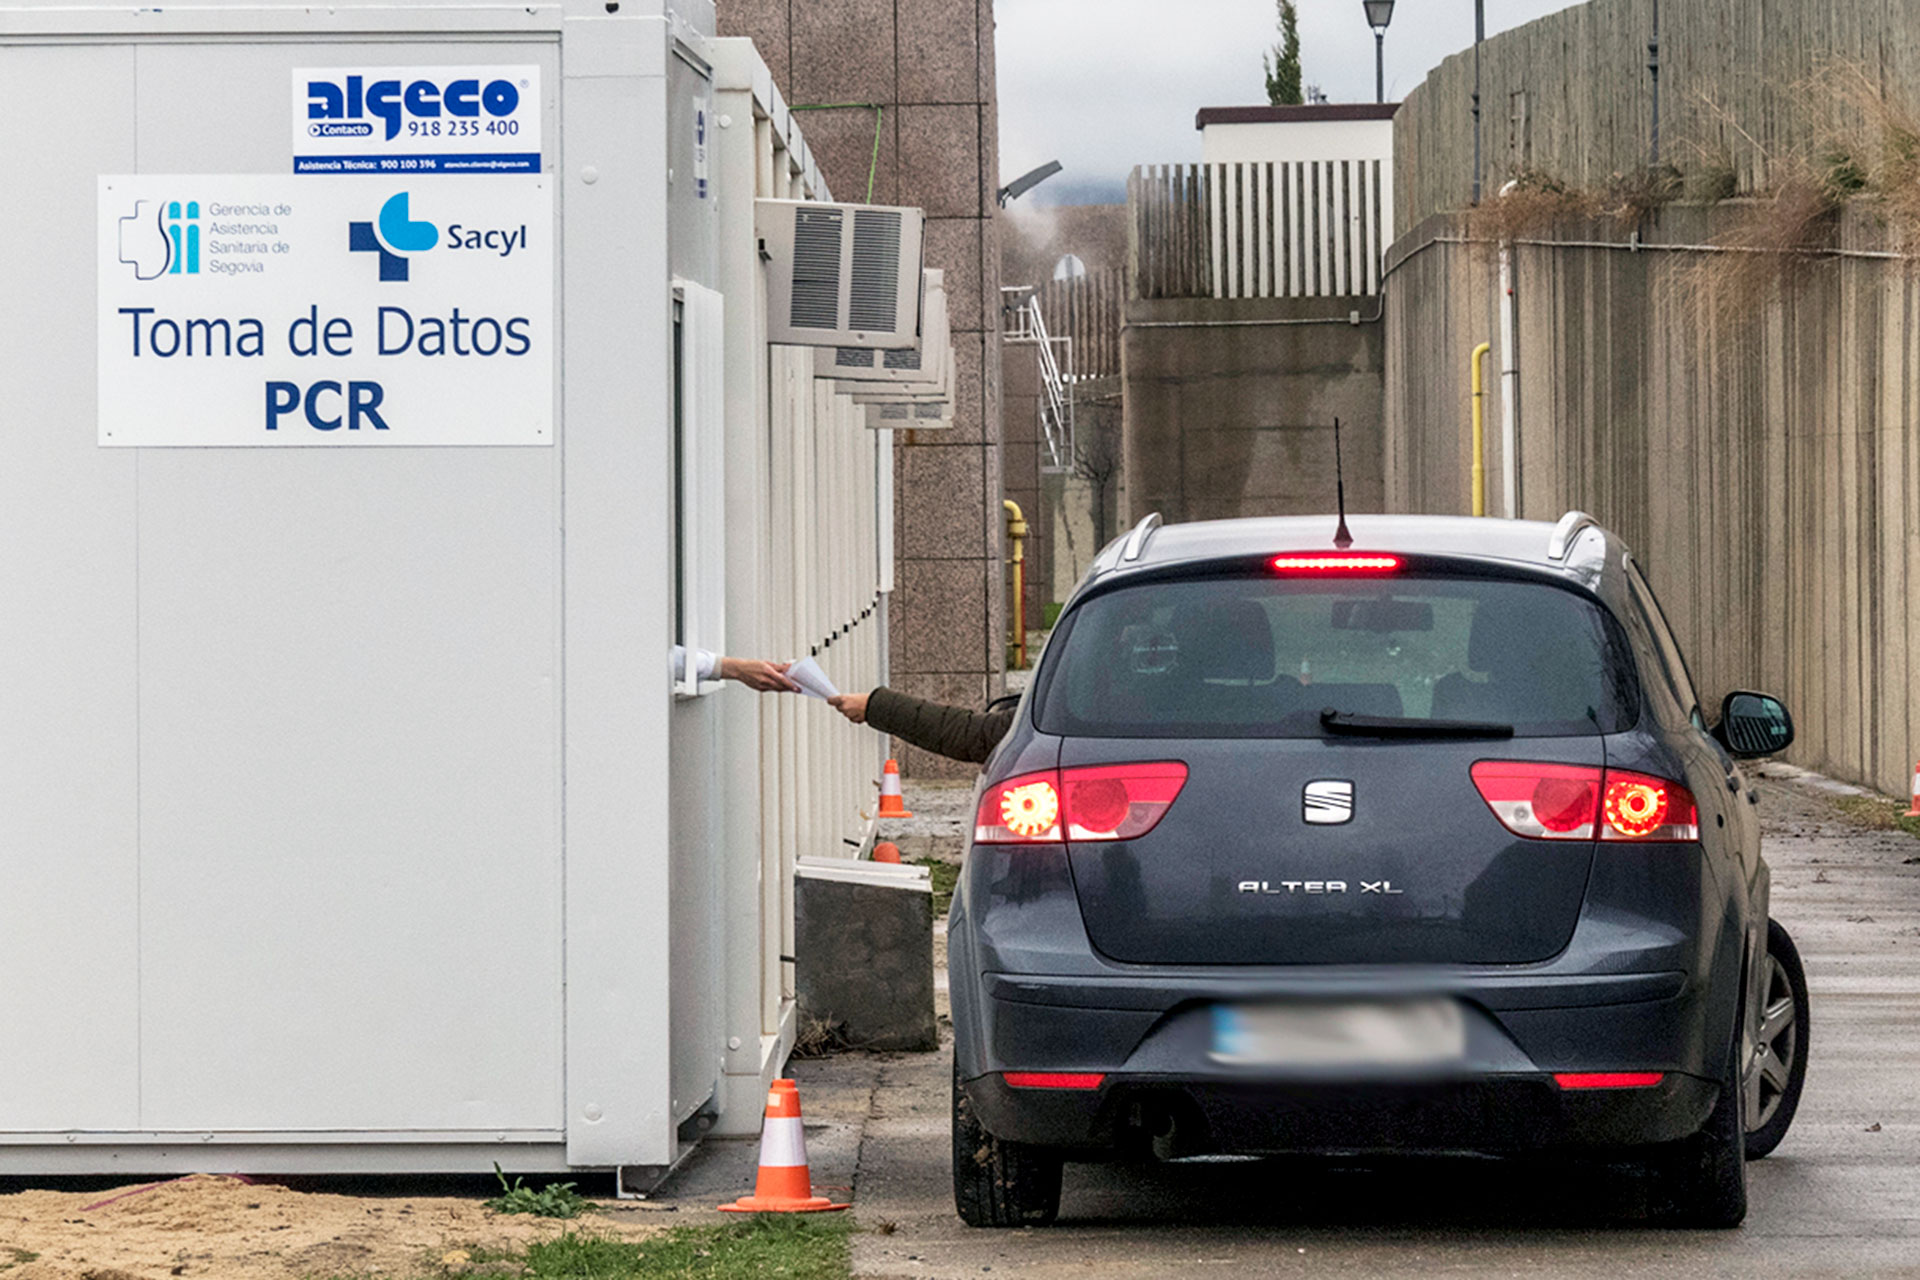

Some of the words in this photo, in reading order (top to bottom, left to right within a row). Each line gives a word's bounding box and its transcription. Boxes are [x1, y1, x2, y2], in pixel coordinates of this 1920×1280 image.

[308, 75, 519, 141] algeco
[322, 124, 370, 136] Contacto
[408, 121, 441, 136] 918
[448, 120, 479, 136] 235
[486, 119, 519, 136] 400
[298, 161, 341, 170] Asistencia
[381, 160, 398, 169] 900
[401, 159, 417, 169] 100
[209, 202, 270, 216] Gerencia
[274, 202, 292, 216] de
[209, 222, 278, 236] Asistencia
[209, 241, 270, 255] Sanitaria
[272, 240, 291, 254] de
[447, 224, 527, 256] Sacyl
[209, 260, 264, 276] Segovia
[118, 307, 265, 357] Toma
[288, 304, 353, 356] de
[378, 306, 531, 356] Datos
[265, 380, 390, 431] PCR
[1360, 881, 1403, 894] XL
